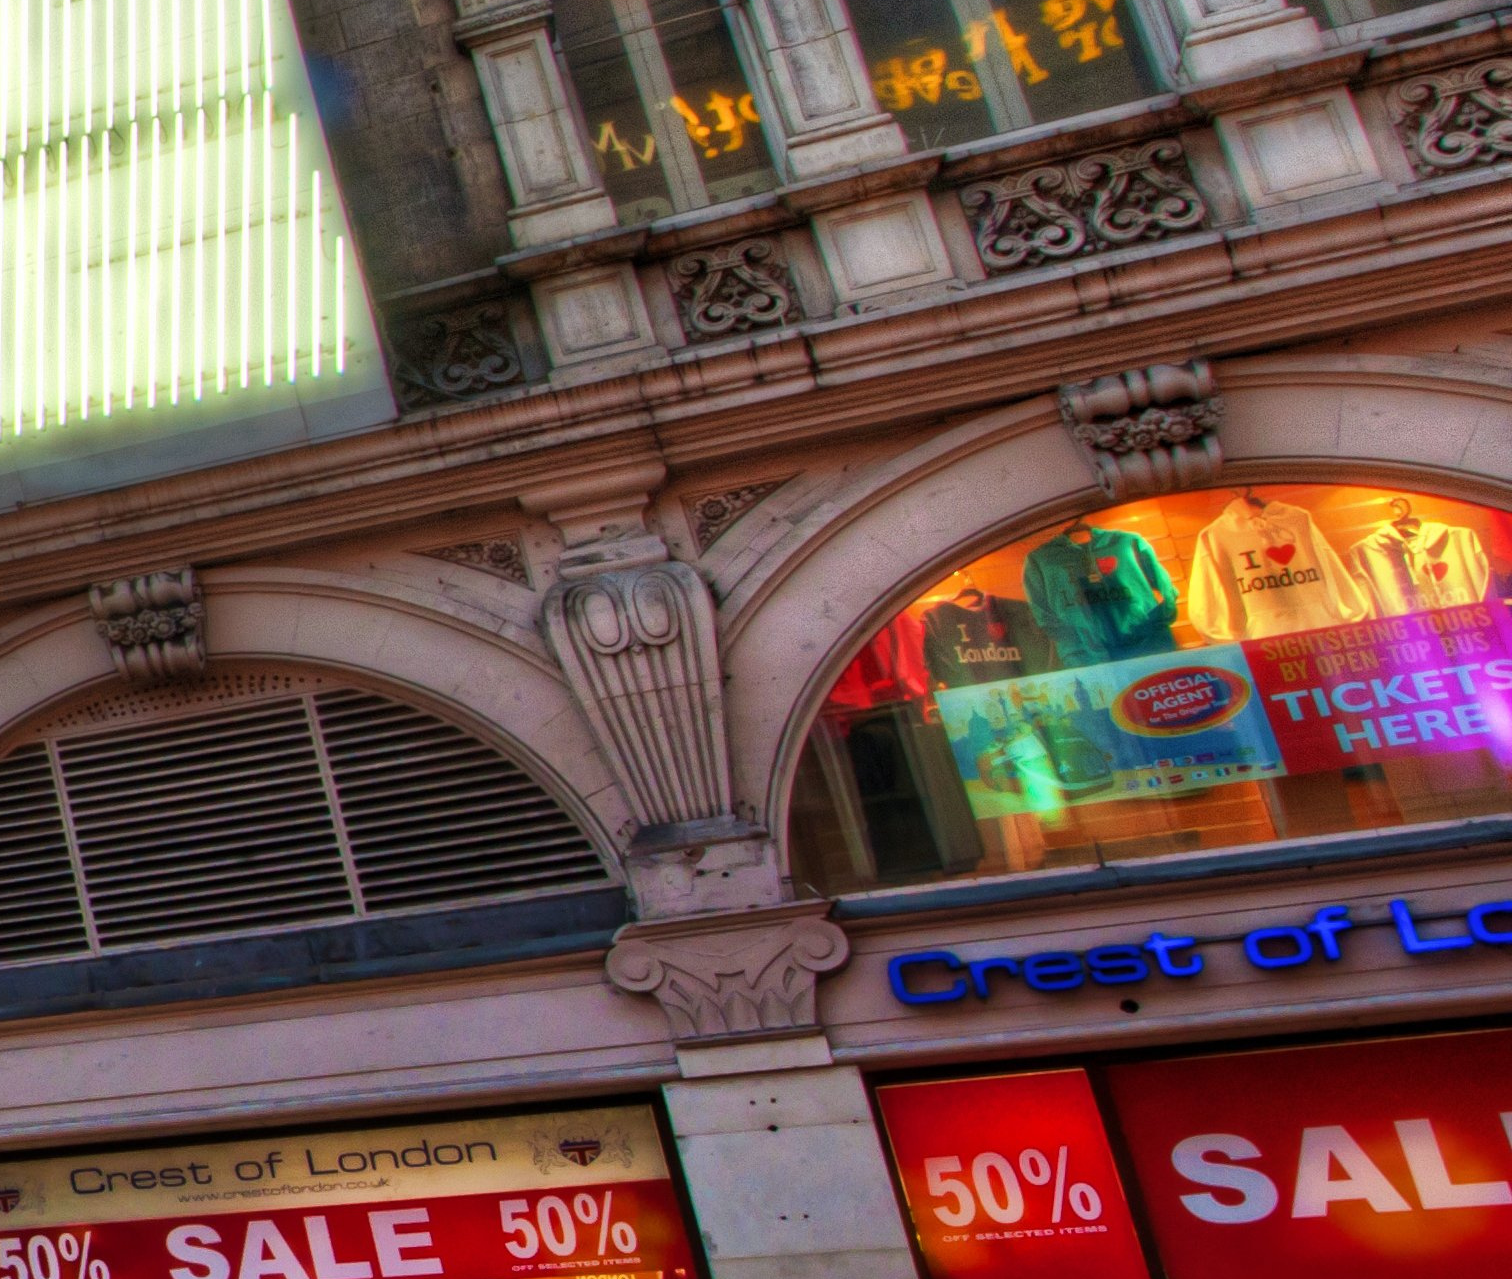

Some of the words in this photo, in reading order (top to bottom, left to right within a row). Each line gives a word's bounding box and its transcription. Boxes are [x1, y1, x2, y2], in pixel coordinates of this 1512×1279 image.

[1239, 550, 1261, 570] I
[1236, 567, 1321, 594] London
[956, 623, 970, 642] I
[1261, 620, 1408, 661] SIGHTSEEING
[1417, 607, 1493, 636] TOURS
[954, 643, 1021, 663] London
[1279, 659, 1308, 682] BY
[1317, 641, 1432, 676] OPEN-TOP
[1440, 631, 1491, 658] BUS
[1133, 672, 1219, 702] OFFICIAL
[1152, 687, 1214, 713] AGENT
[1271, 658, 1512, 721] TICKETS
[1333, 702, 1492, 753] HERE
[888, 932, 1205, 1006] Crest
[1243, 905, 1352, 970] of
[70, 1161, 214, 1195] Crest
[234, 1151, 283, 1182] of
[304, 1139, 497, 1177] London
[924, 1145, 1102, 1227] 50%
[1170, 1110, 1512, 1225] SAL
[176, 1176, 392, 1204] www.crestoflondon.co.uk
[498, 1190, 638, 1260] 50%
[942, 1234, 970, 1243] OFF
[975, 1229, 1055, 1241] SELECTED
[1059, 1224, 1109, 1235] ITEMS
